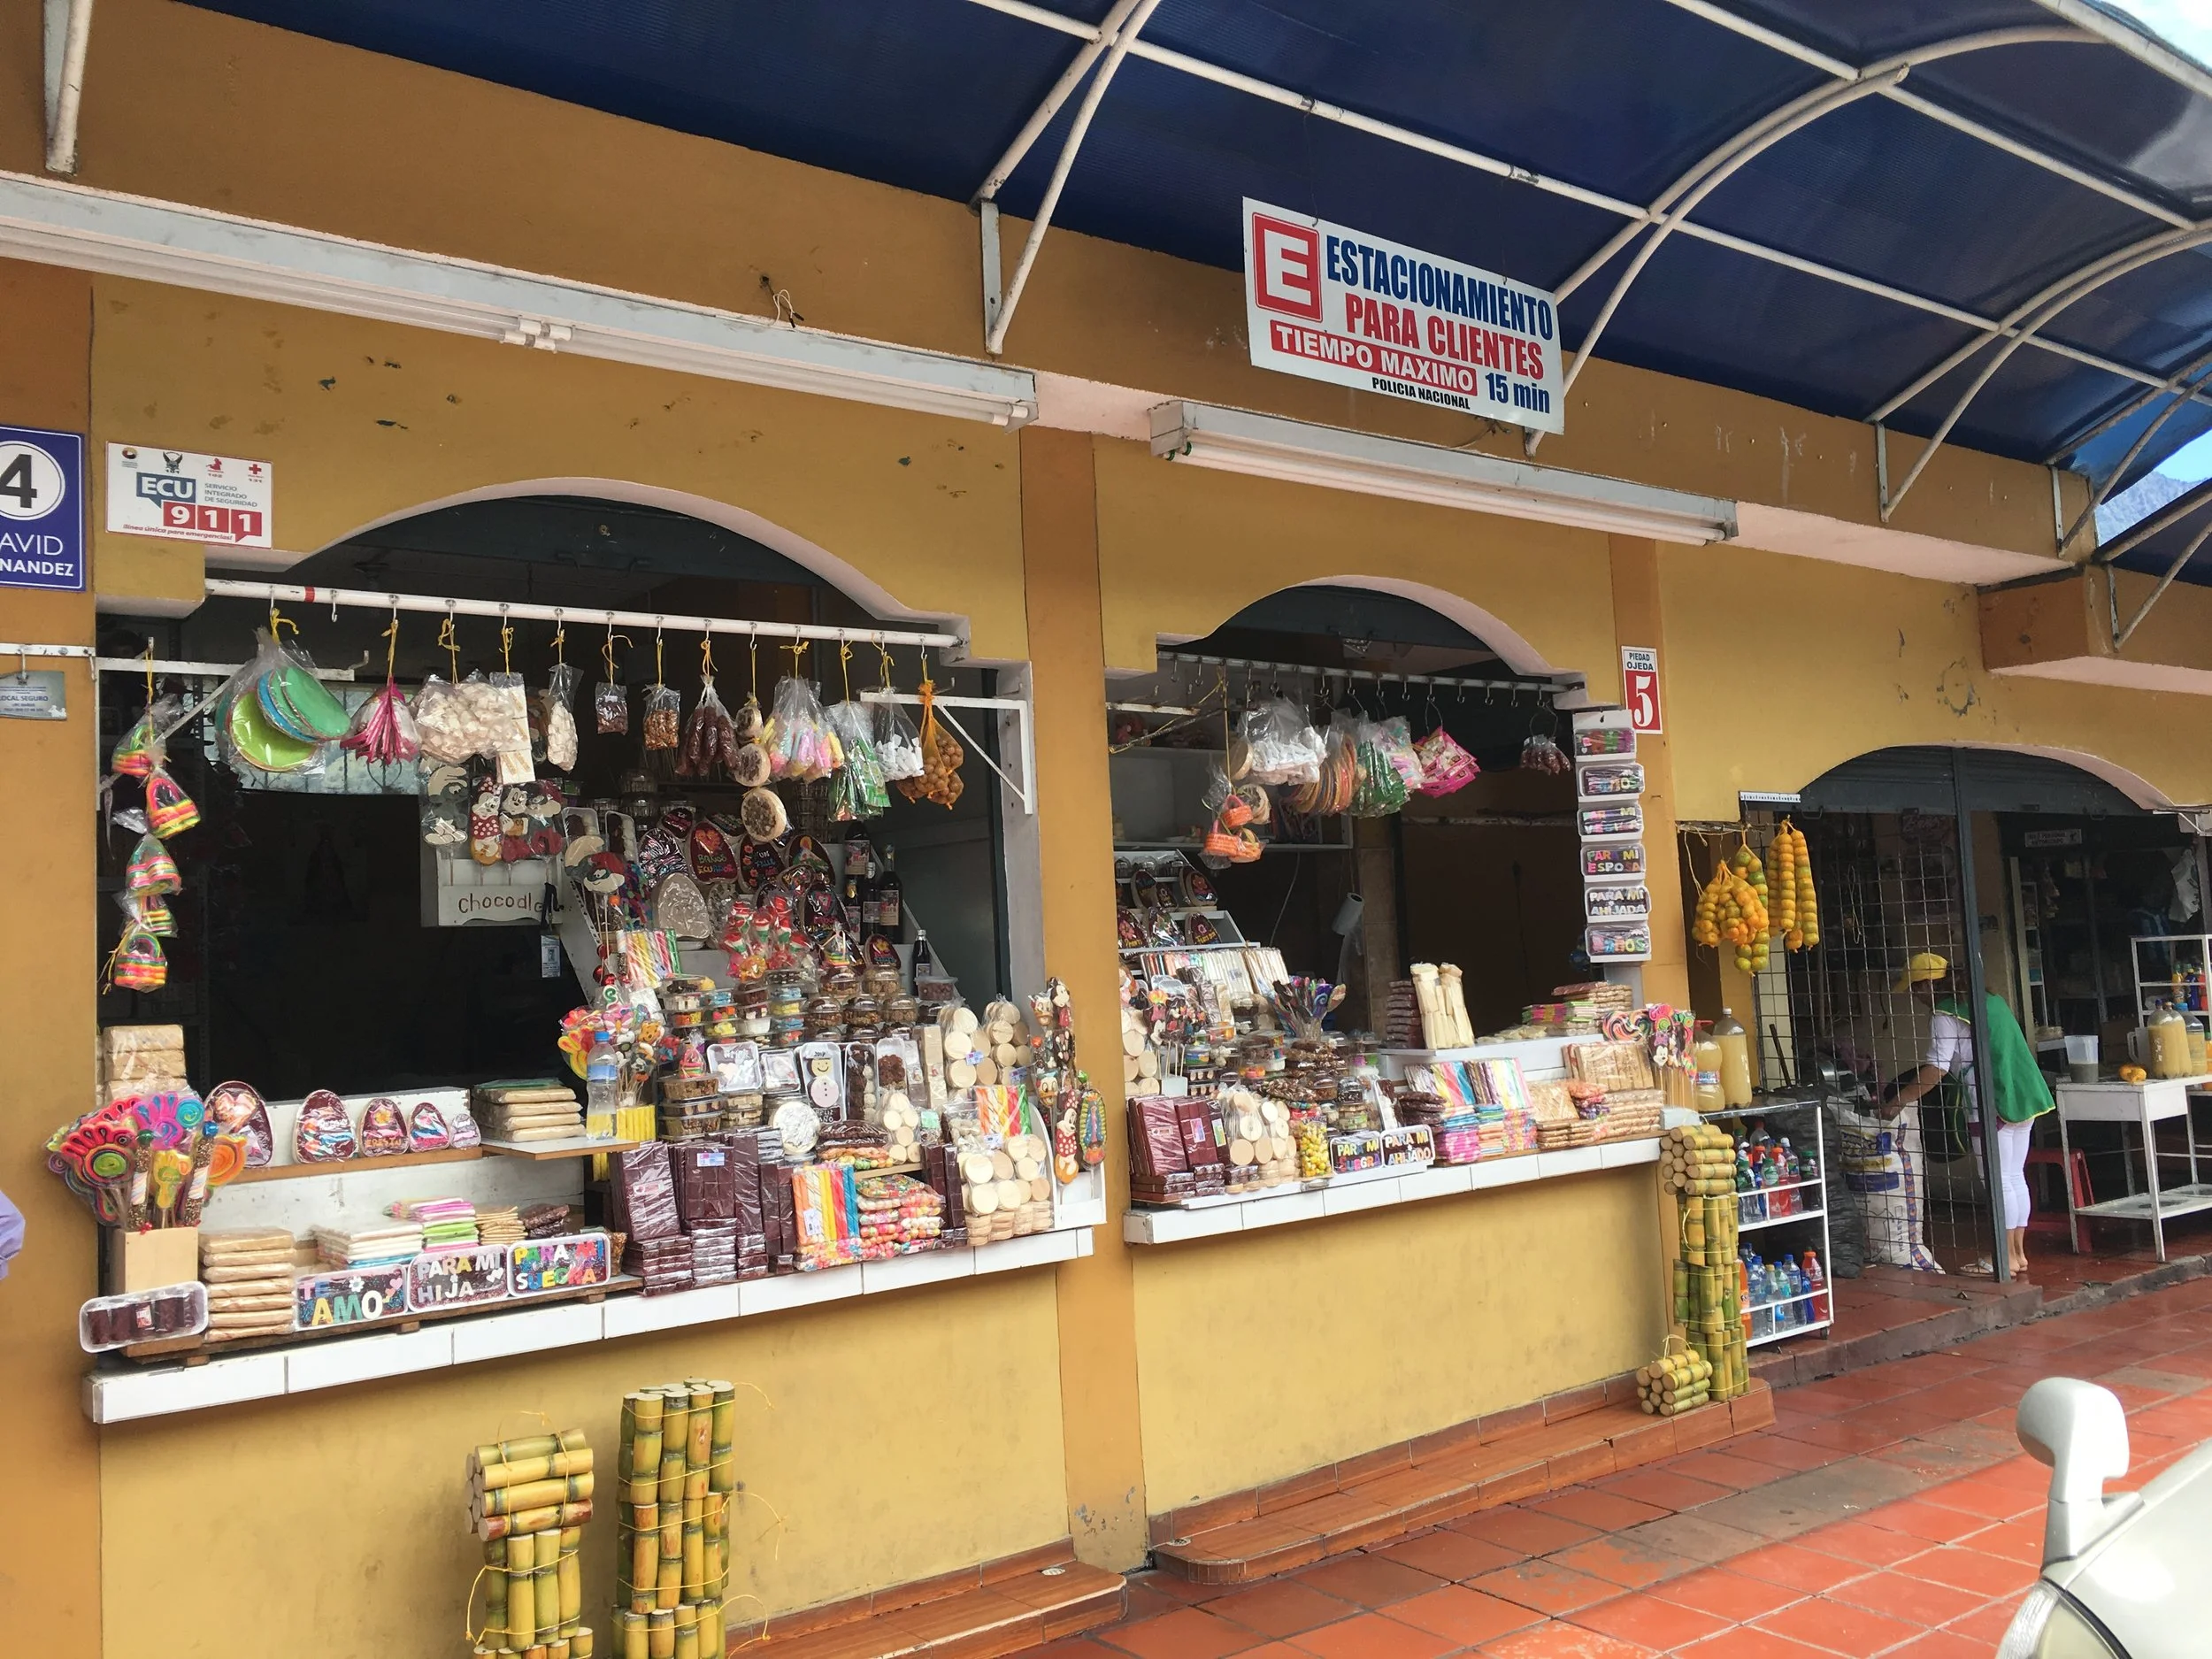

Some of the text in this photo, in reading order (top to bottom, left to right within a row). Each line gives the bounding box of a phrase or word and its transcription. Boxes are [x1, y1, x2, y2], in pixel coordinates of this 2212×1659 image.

[1261, 225, 1315, 310] E
[1326, 234, 1554, 341] ESTACIONAMIENTO
[1345, 292, 1544, 380] PARA CLIENTES
[1275, 324, 1474, 392] TIEMPO MAXIMO
[1372, 377, 1471, 410] POLICIA NACIONAL
[1485, 373, 1550, 414] 15 min
[0, 453, 37, 509] 4
[141, 476, 193, 500] ECU
[204, 482, 238, 492] SERVICIO
[204, 489, 248, 500] INTEGRADO
[216, 497, 258, 508] SEGURIDAD
[170, 505, 251, 533] 911
[1626, 661, 1654, 672] OJEDA
[1628, 652, 1650, 662] PIEDAD
[1633, 675, 1654, 727] 5
[1586, 849, 1640, 862] PARA MI
[1587, 862, 1640, 873] ESPOSA
[1589, 889, 1644, 902] PARA MI
[1591, 904, 1647, 916] AHIJADA
[1337, 1138, 1379, 1156] PARA MI
[1385, 1130, 1429, 1148] PARA MI
[1338, 1152, 1381, 1172] SUEGRA
[1387, 1148, 1432, 1166] AHIJADO
[514, 1238, 603, 1265] PARA MI
[417, 1252, 501, 1280] PARA MI
[515, 1267, 597, 1290] SUEGRA
[298, 1280, 330, 1301] TE
[417, 1280, 474, 1304] HIJA
[311, 1289, 383, 1326] AMO
